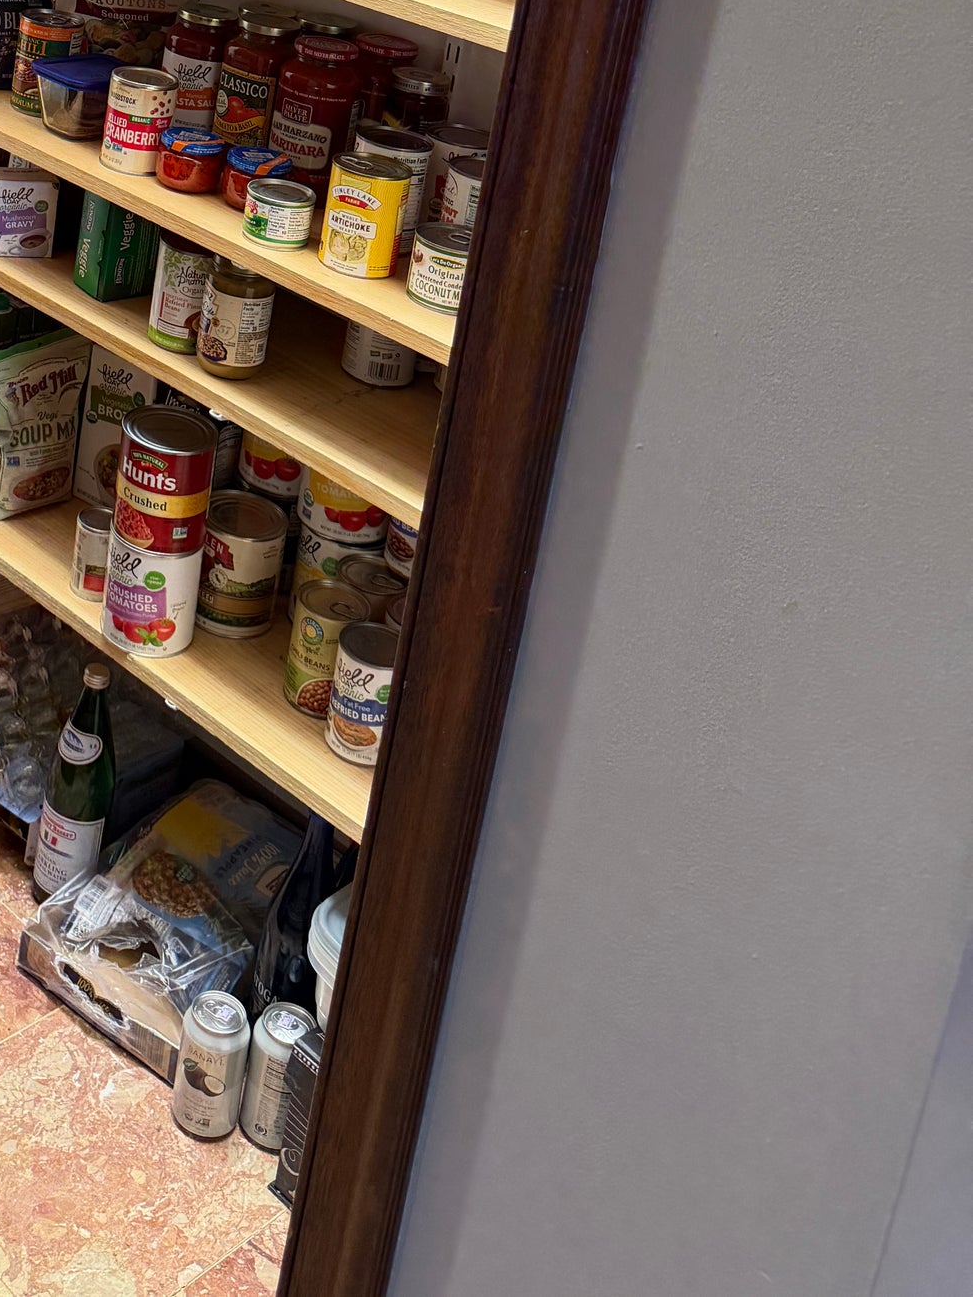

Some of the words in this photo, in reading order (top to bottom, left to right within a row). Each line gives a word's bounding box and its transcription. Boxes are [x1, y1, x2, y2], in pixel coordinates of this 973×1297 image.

[101, 9, 150, 22] Seasoned
[174, 63, 212, 83] field
[220, 71, 268, 99] CLASSICO
[283, 110, 308, 123] PALATE
[285, 103, 308, 116] SILVER
[131, 116, 151, 124] ORGANIC
[237, 121, 255, 131] BASIL
[106, 122, 162, 146] CRANBERRY
[283, 123, 327, 144] MARZANO
[334, 187, 354, 196] FINLEY
[357, 191, 377, 205] LANE
[0, 203, 27, 212] organic
[119, 212, 135, 251] Veggie
[331, 215, 371, 232] ARTICHOKE
[78, 238, 91, 277] Veggie
[416, 270, 444, 286] Sweetened
[428, 265, 463, 281] Original
[415, 280, 451, 299] COCONUT
[165, 298, 186, 307] Refried
[217, 326, 232, 334] 57
[19, 374, 47, 407] Red
[48, 363, 78, 394] Mill
[98, 364, 134, 391] field
[99, 382, 127, 396] organic
[98, 404, 126, 421] BRO
[10, 423, 53, 448] SOUP
[143, 455, 164, 468] NATURAL
[123, 487, 167, 512] Crushed
[109, 582, 153, 603] CRUSHED
[303, 656, 331, 672] BEANS
[338, 658, 375, 694] field
[353, 702, 371, 713] Free
